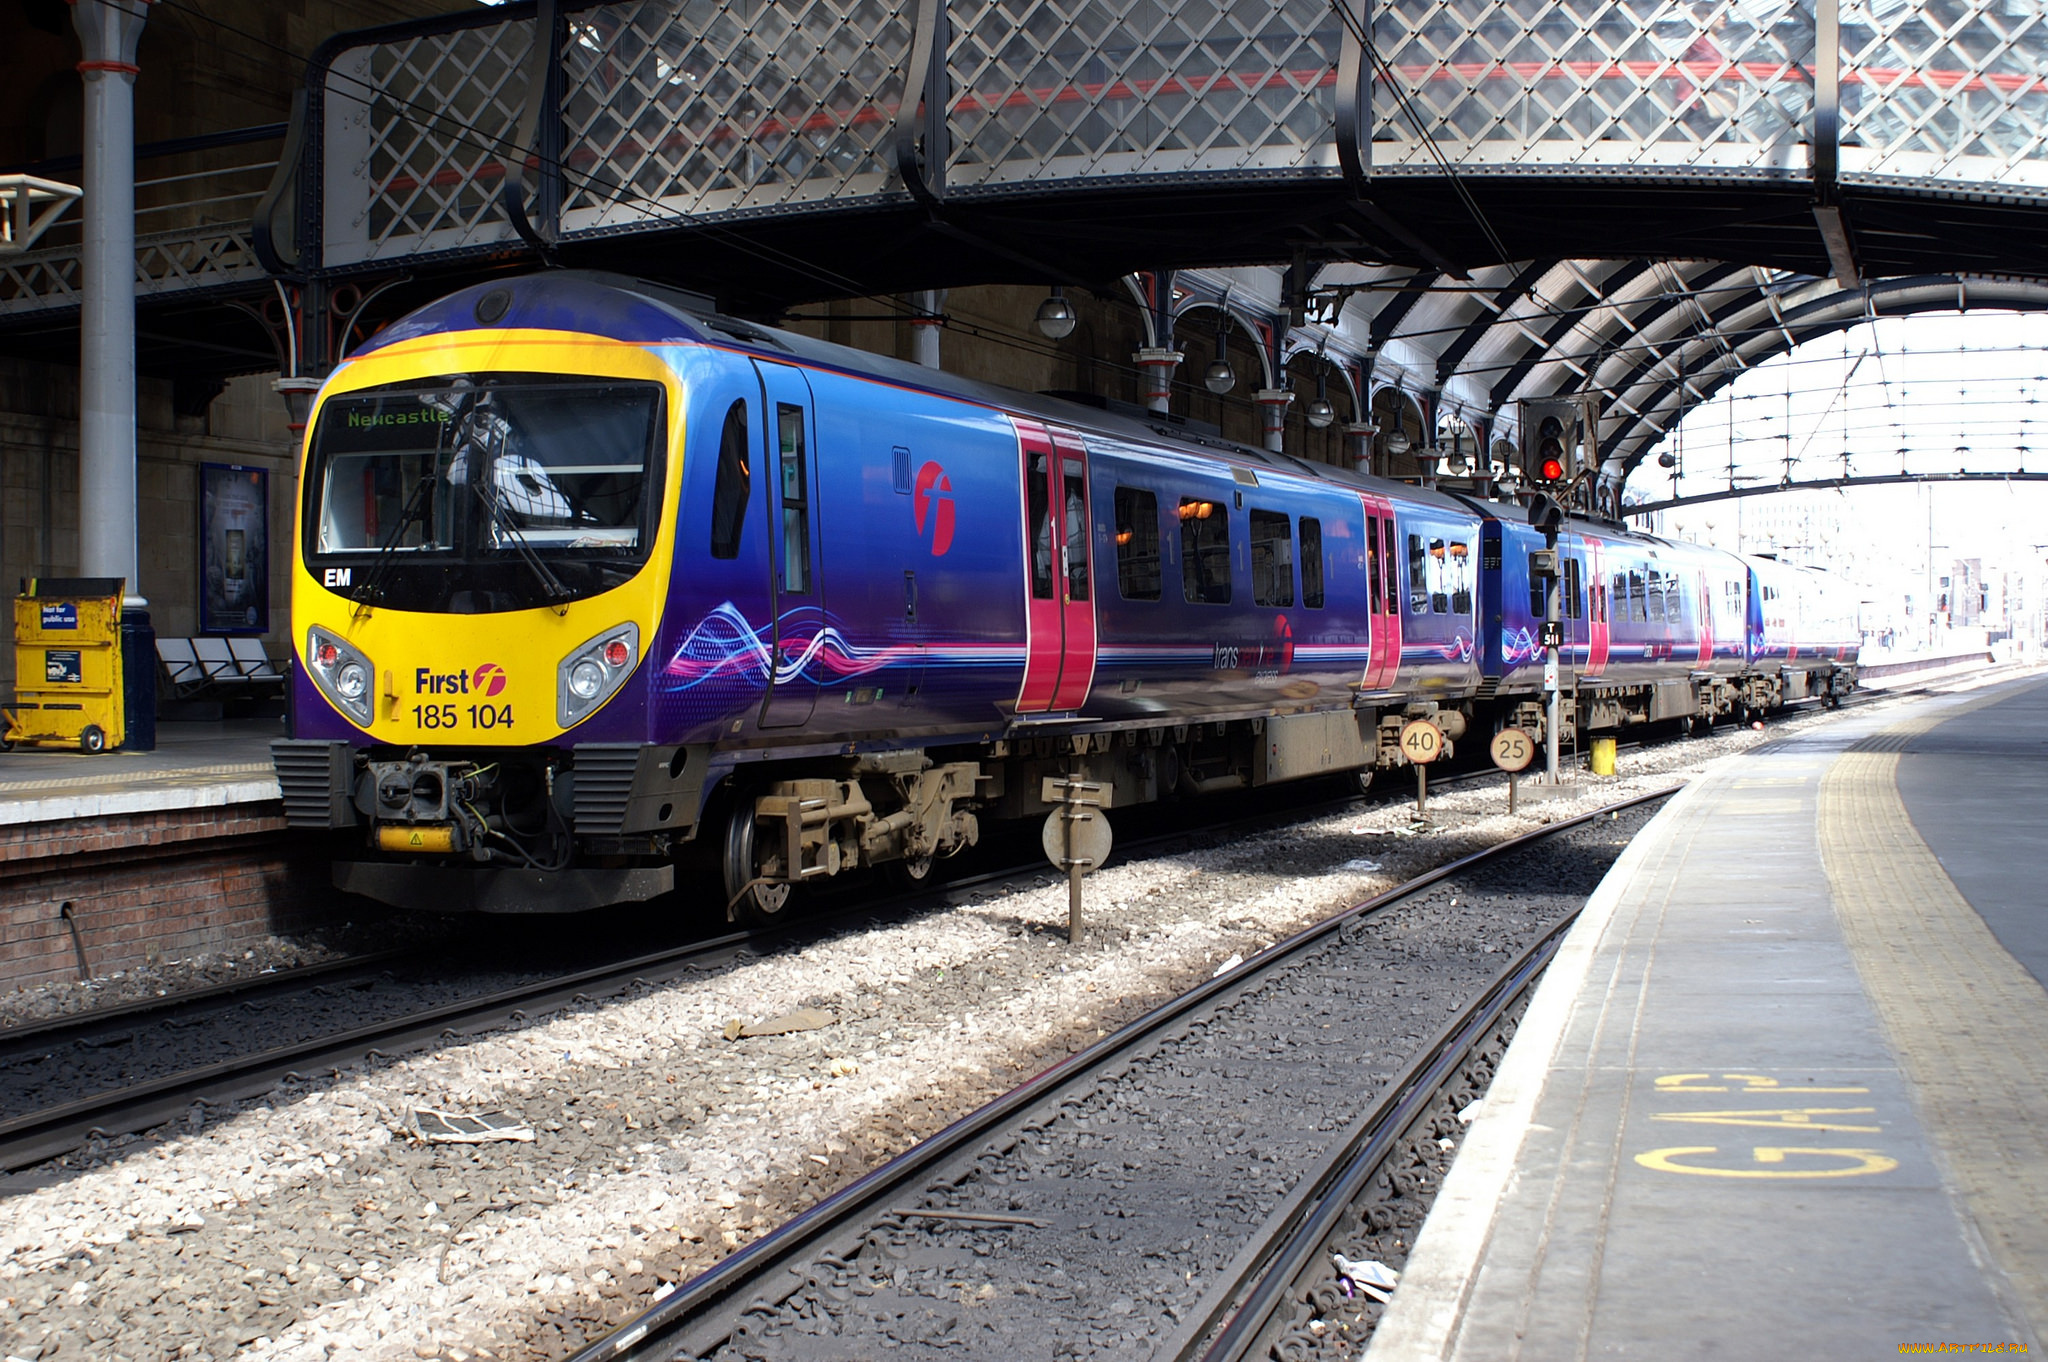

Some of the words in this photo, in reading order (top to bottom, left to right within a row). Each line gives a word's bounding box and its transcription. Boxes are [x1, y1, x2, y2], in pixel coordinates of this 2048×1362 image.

[348, 408, 449, 427] Newcastle
[324, 568, 351, 587] EM
[1547, 623, 1555, 633] T
[1544, 634, 1559, 645] 511
[416, 667, 469, 694] First
[412, 704, 458, 729] 185
[467, 704, 515, 729] 104
[1406, 732, 1434, 751] 40
[1499, 740, 1524, 759] 25
